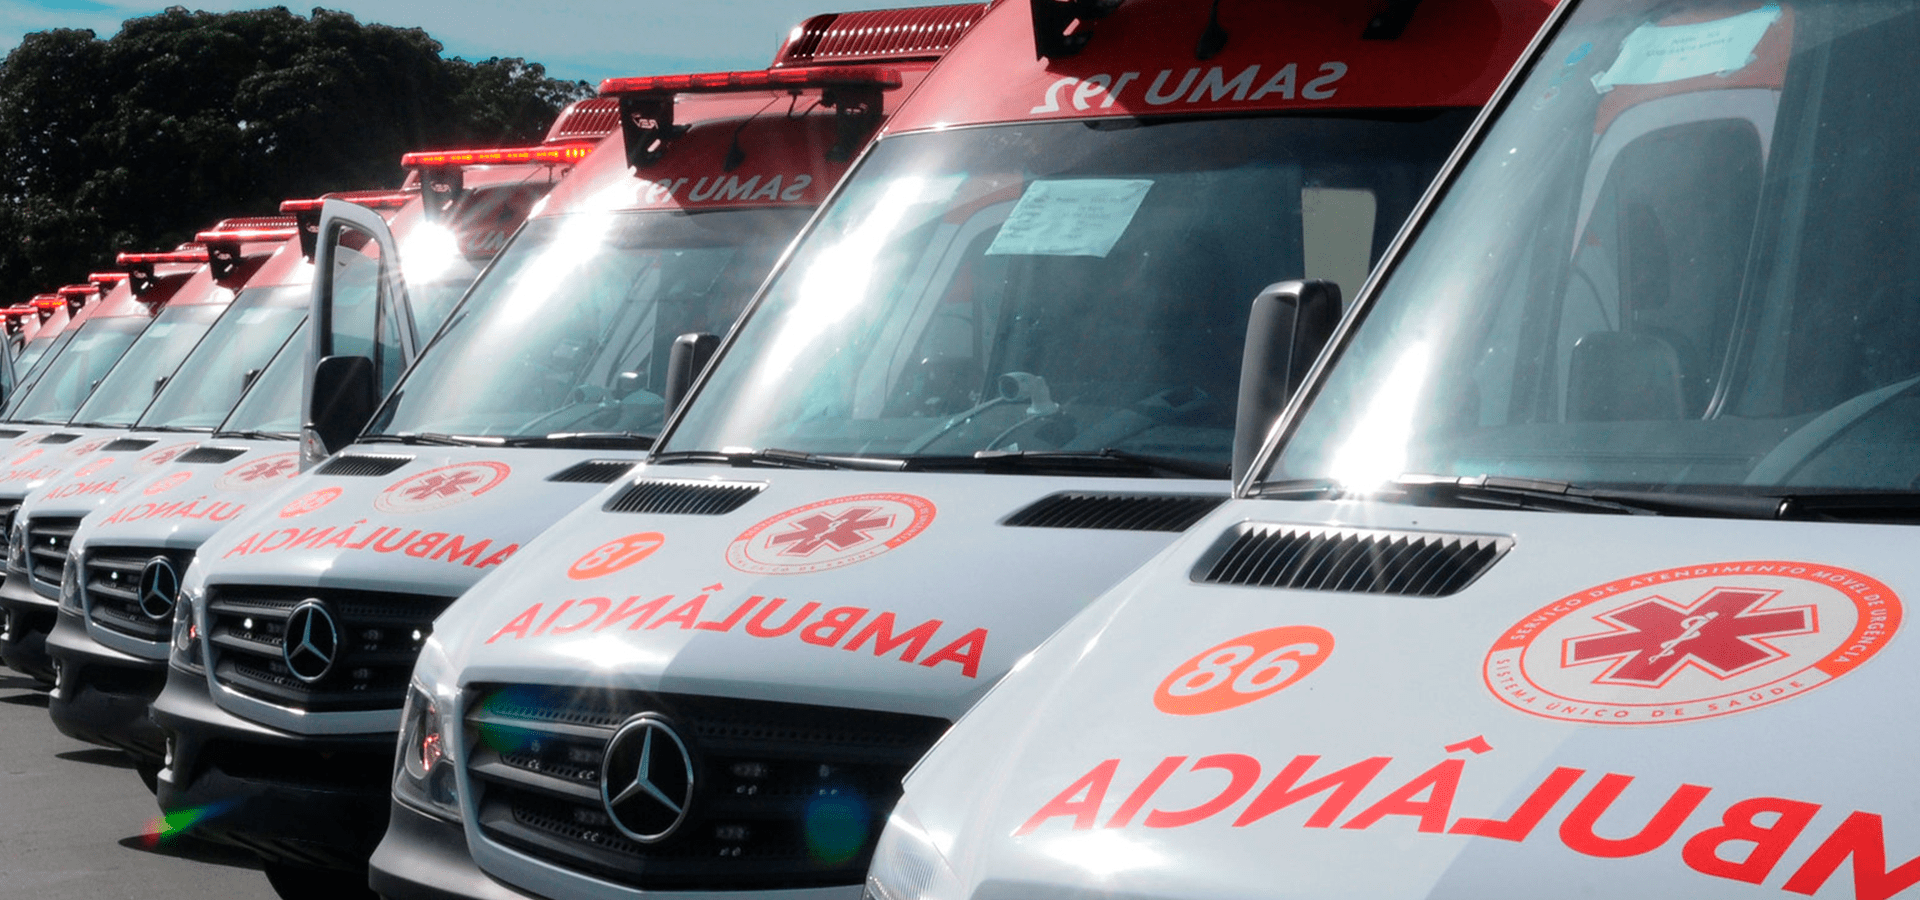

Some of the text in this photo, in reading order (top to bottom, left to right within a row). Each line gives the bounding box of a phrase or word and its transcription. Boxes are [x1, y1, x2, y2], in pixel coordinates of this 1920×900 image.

[576, 541, 661, 570] 87
[1510, 564, 1888, 663] SERVIÇO DE ATENDIMENTO MÓVEL DE URGÊNCIA
[1168, 642, 1320, 696] 86
[1496, 657, 1804, 718] SISTEMA ÚNICO DE SAÚDE
